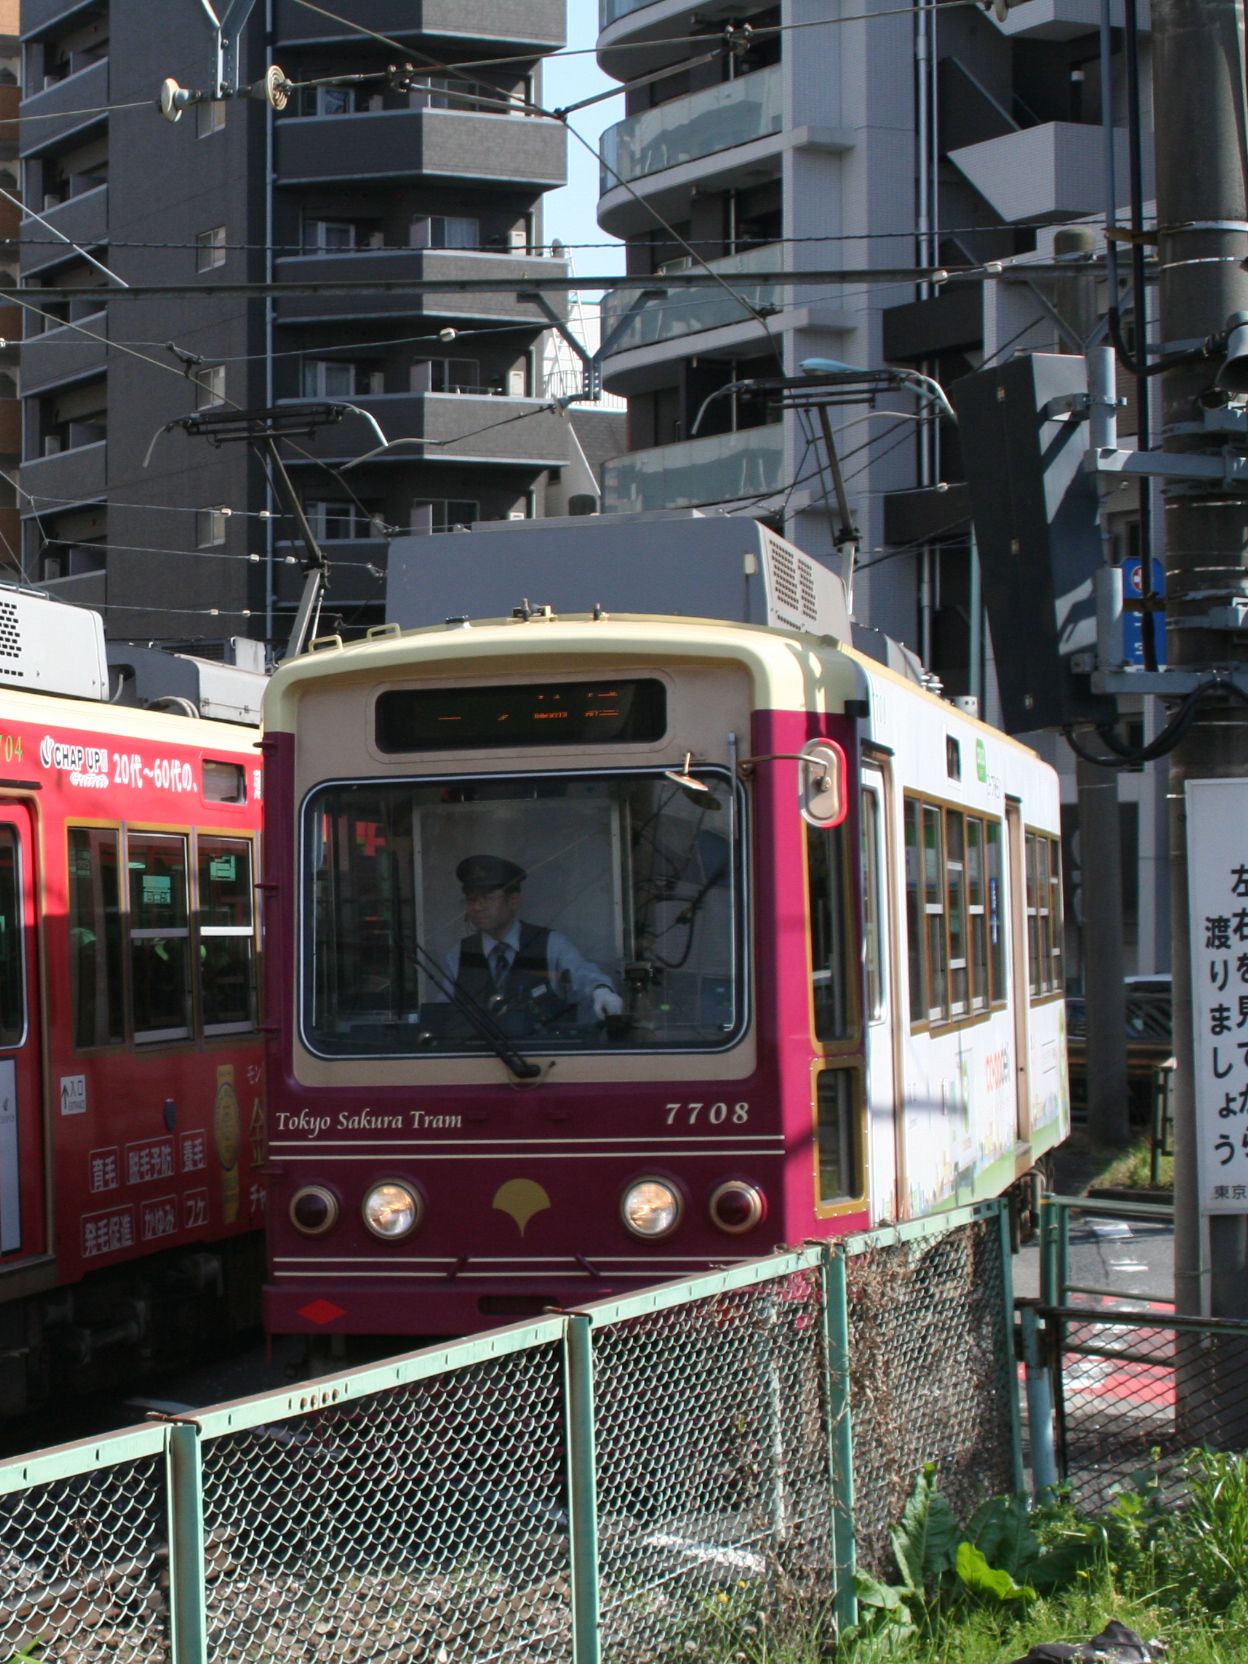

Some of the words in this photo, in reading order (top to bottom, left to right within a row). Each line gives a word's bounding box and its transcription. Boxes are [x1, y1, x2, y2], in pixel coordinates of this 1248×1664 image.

[55, 745, 83, 770] CHAP
[87, 749, 101, 771] UP
[1205, 915, 1237, 1166] 渡りましょう
[276, 1108, 331, 1138] Tokyo
[337, 1107, 403, 1130] Sakura
[410, 1110, 462, 1129] Tram
[665, 1102, 749, 1125] 7708
[1214, 1184, 1247, 1200] 東京
